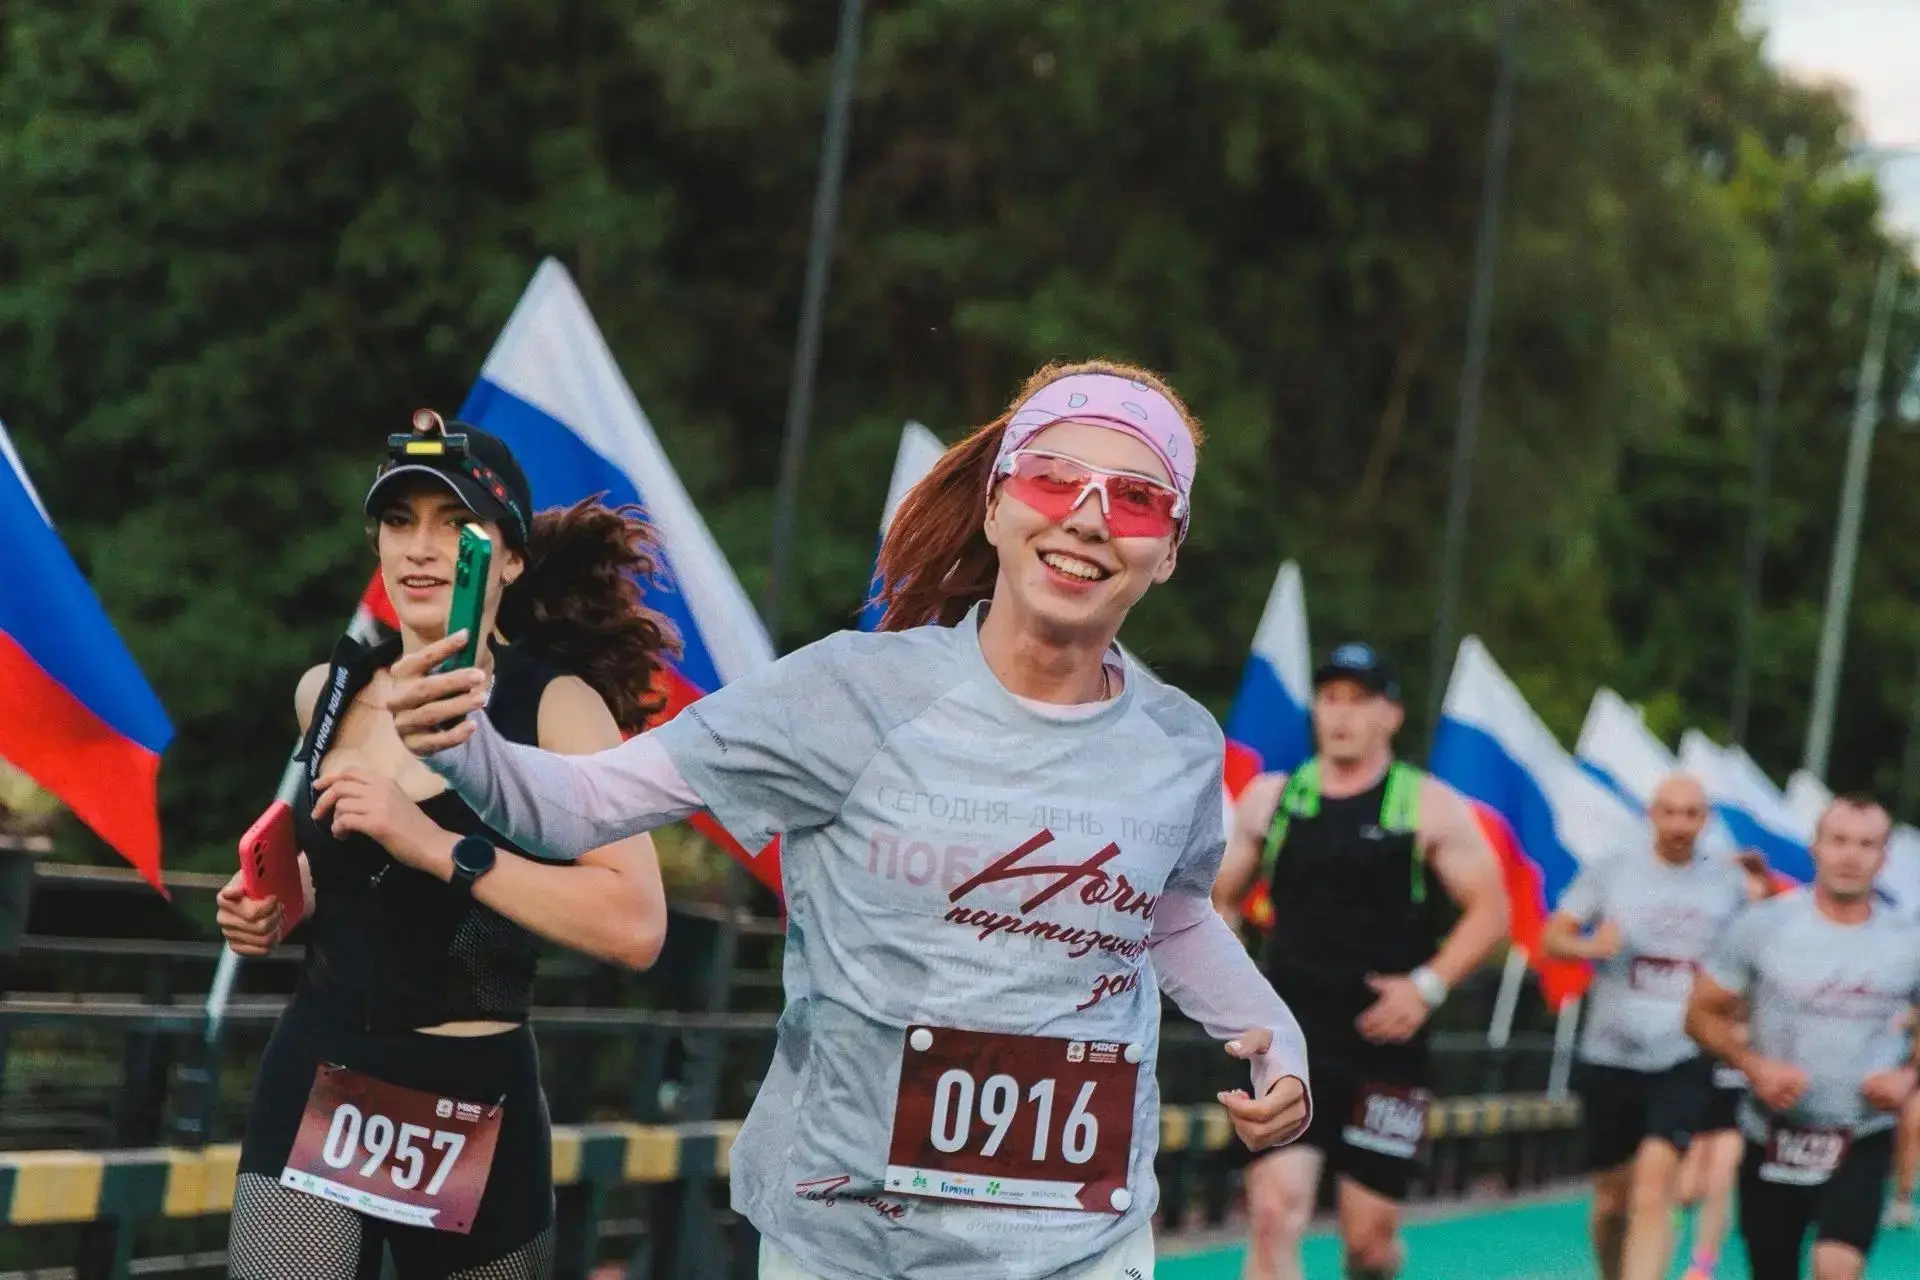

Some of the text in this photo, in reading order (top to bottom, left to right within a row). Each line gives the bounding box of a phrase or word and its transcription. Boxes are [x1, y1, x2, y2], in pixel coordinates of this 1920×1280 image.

[314, 715, 334, 750] BONA
[322, 1103, 467, 1196] 0957
[930, 1069, 1099, 1164] 0916
